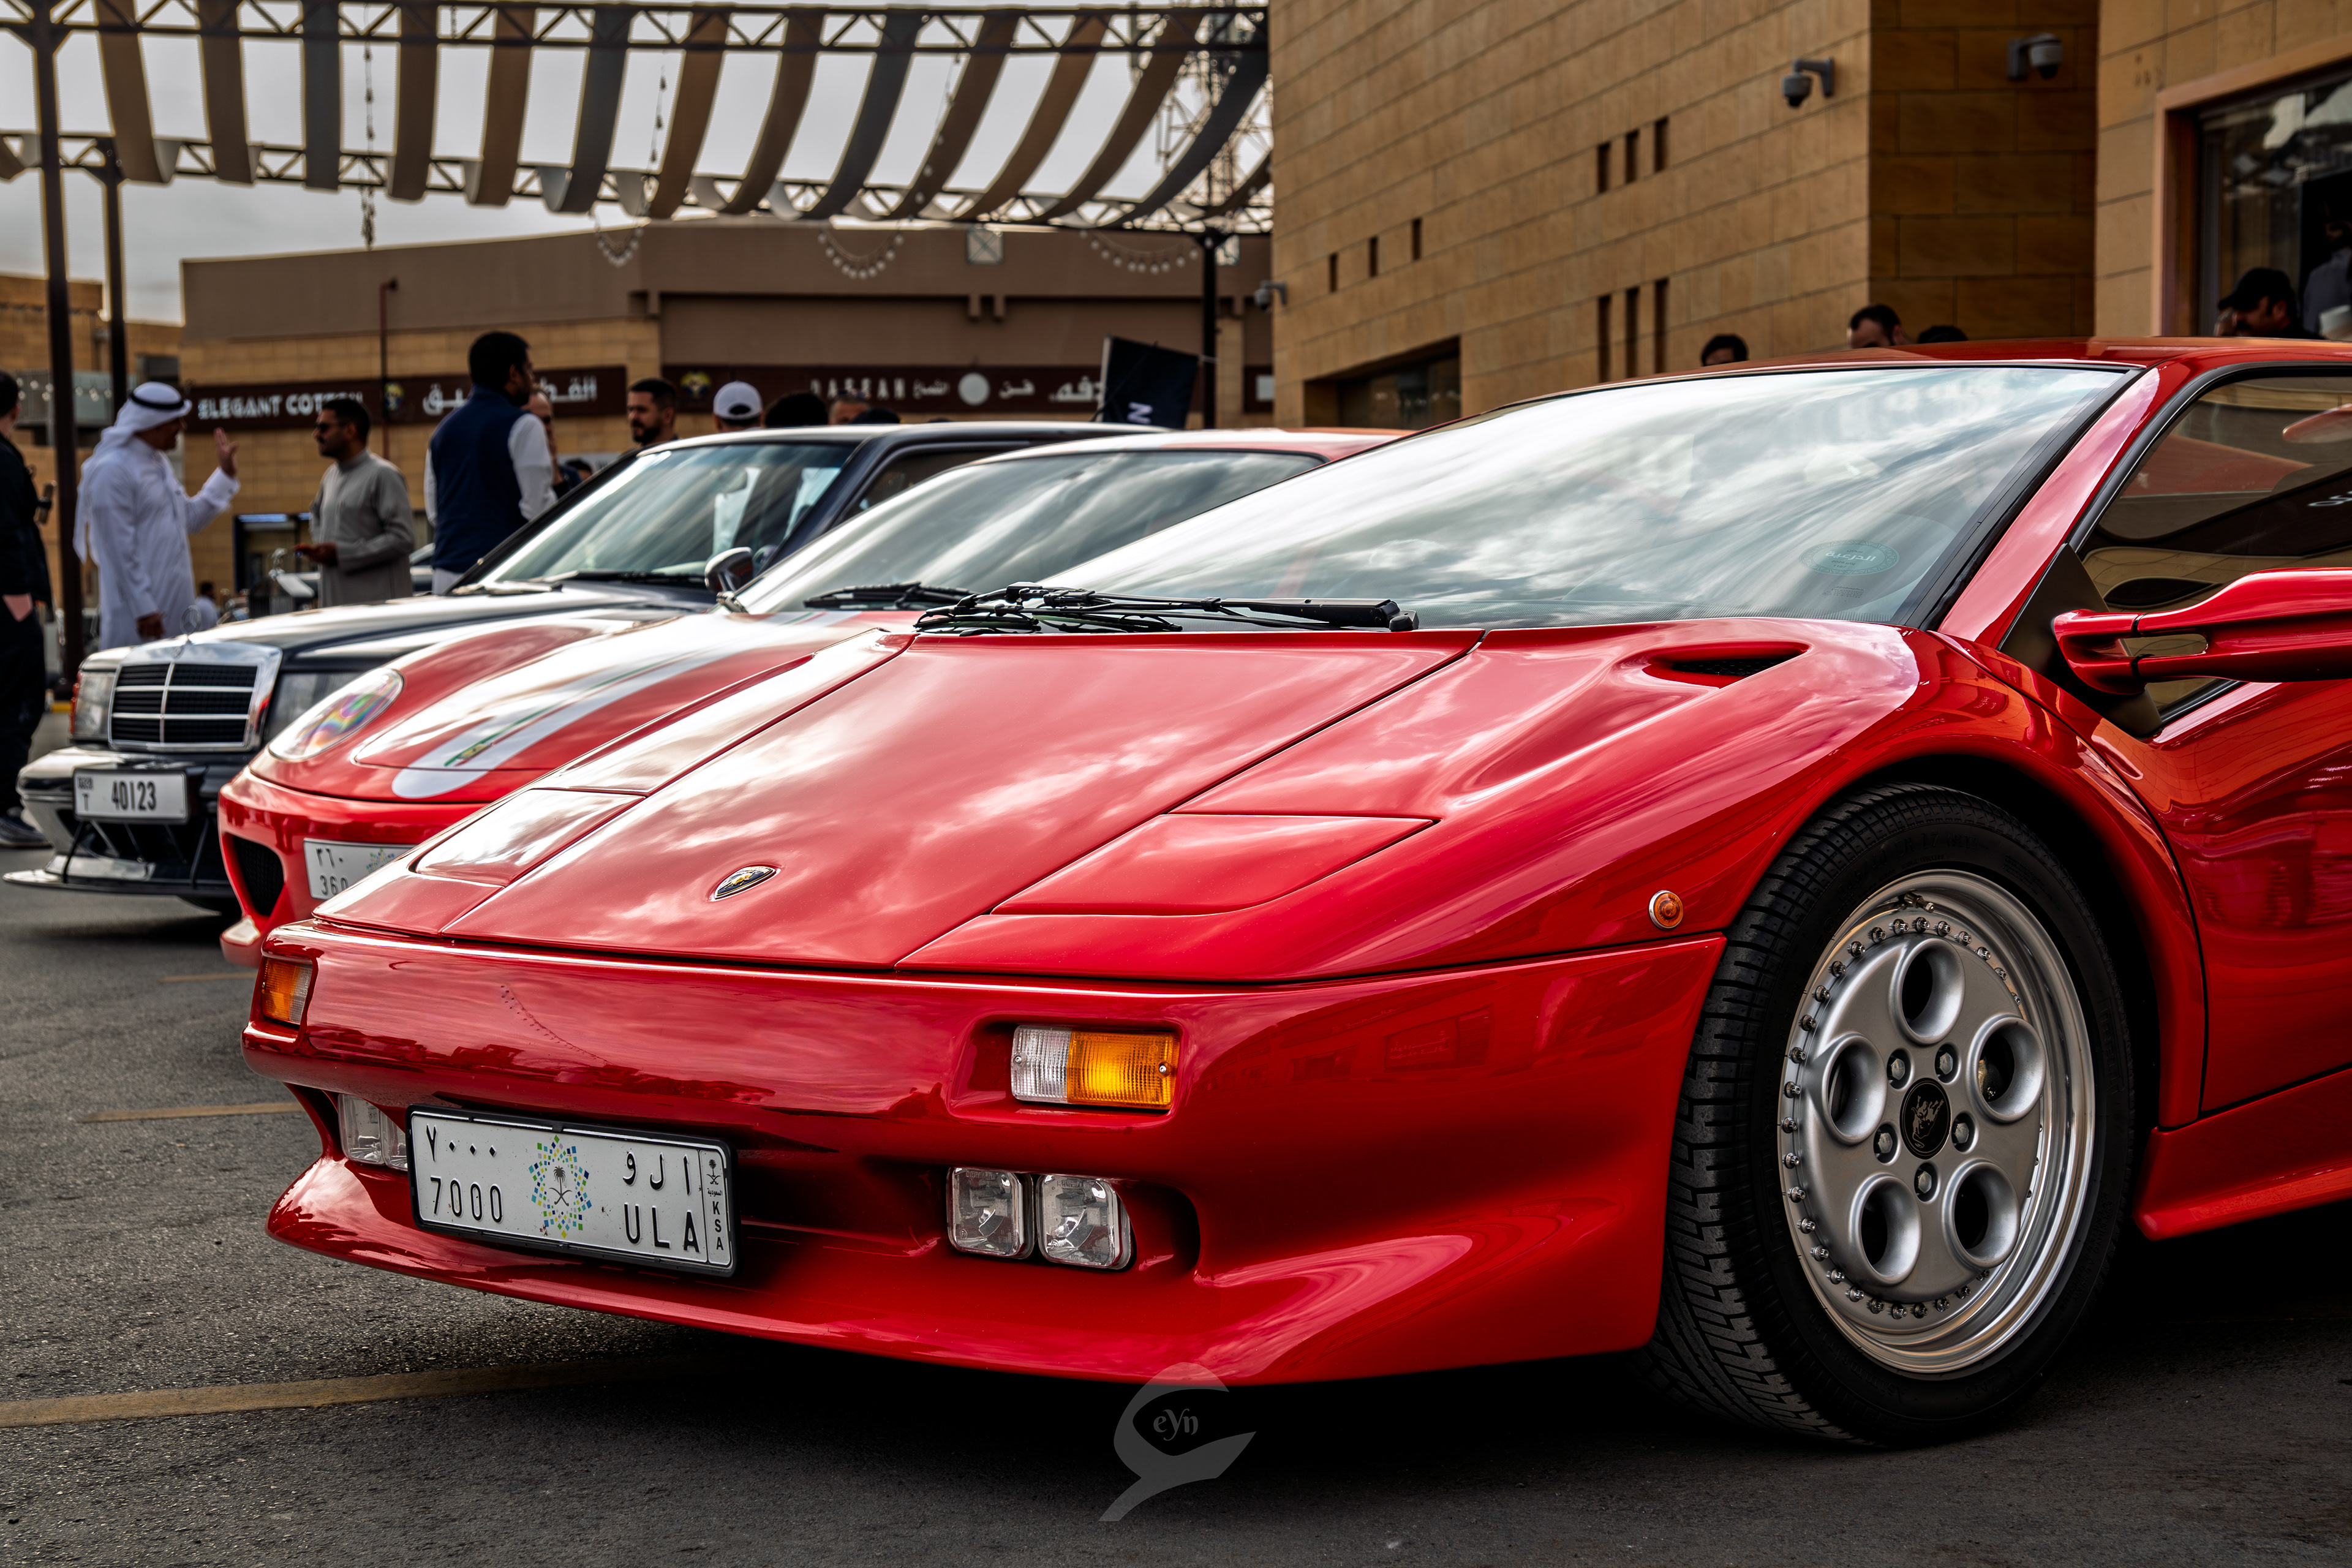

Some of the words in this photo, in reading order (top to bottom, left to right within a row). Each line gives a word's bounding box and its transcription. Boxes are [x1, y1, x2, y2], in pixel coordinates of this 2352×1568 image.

[198, 394, 283, 420] ELEGANT
[285, 390, 364, 417] COT
[1825, 551, 1877, 562] الدرعية
[82, 793, 89, 811] T
[111, 780, 157, 811] 40123
[320, 873, 349, 895] 360
[429, 1175, 503, 1224] 7000
[707, 1188, 723, 1197] السعودية
[624, 1202, 700, 1254] ULA
[712, 1200, 724, 1251] KSA
